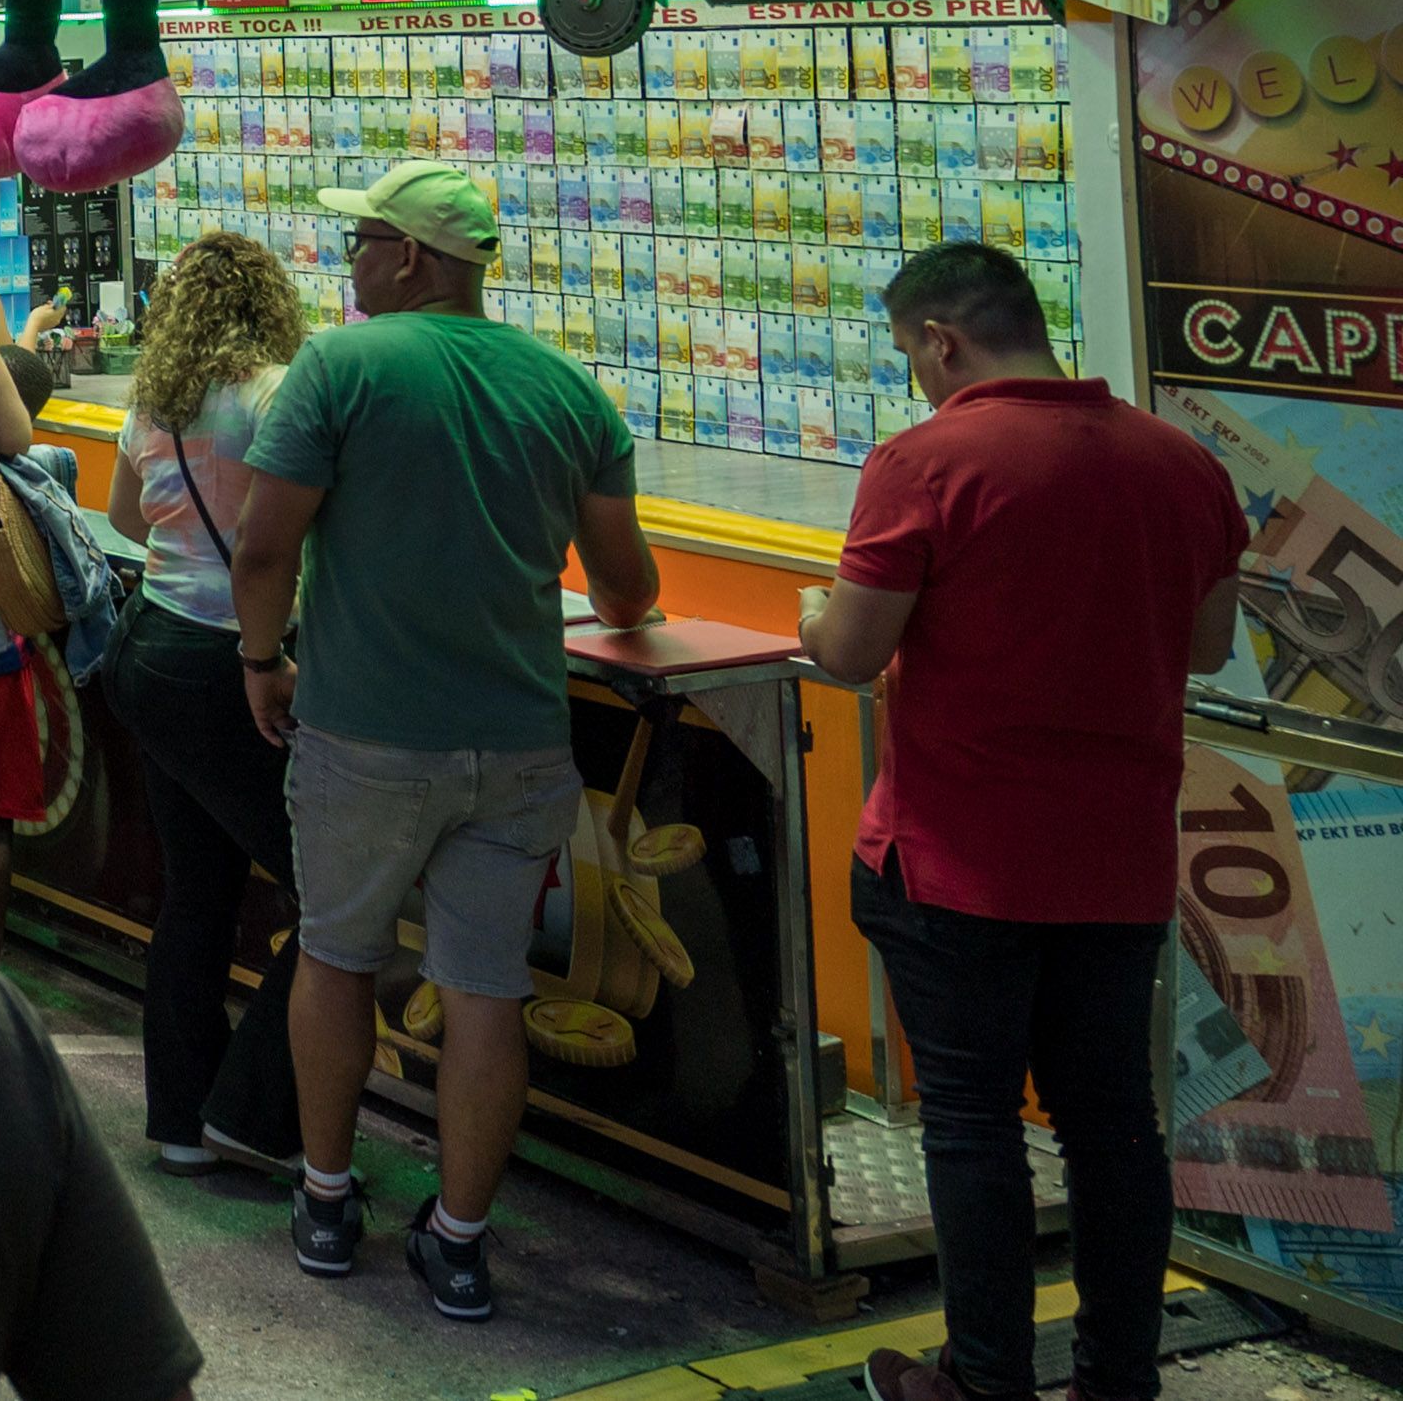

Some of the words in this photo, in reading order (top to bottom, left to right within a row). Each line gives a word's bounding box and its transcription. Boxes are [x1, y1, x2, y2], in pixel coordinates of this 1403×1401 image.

[160, 20, 233, 35] IEMPRE
[240, 19, 298, 34] TOCA
[304, 18, 322, 32] !!!
[359, 10, 446, 31] DETRÁS
[462, 13, 494, 28] DE
[503, 10, 543, 28] LO
[654, 9, 698, 24] TES
[748, 1, 855, 20] ESTAN
[868, 0, 933, 18] LOS
[957, 67, 971, 92] 200
[1038, 66, 1053, 92] 200
[1178, 54, 1357, 114] WEL
[962, 149, 975, 166] 20
[925, 217, 939, 242] 200
[1050, 229, 1064, 248] 20
[1182, 399, 1210, 421] EKT
[1212, 420, 1240, 446] EKP
[1243, 443, 1270, 466] 2002
[1296, 827, 1316, 841] KP
[1322, 825, 1349, 840] EKT
[1354, 823, 1385, 838] EKB
[1181, 783, 1291, 918] 10
